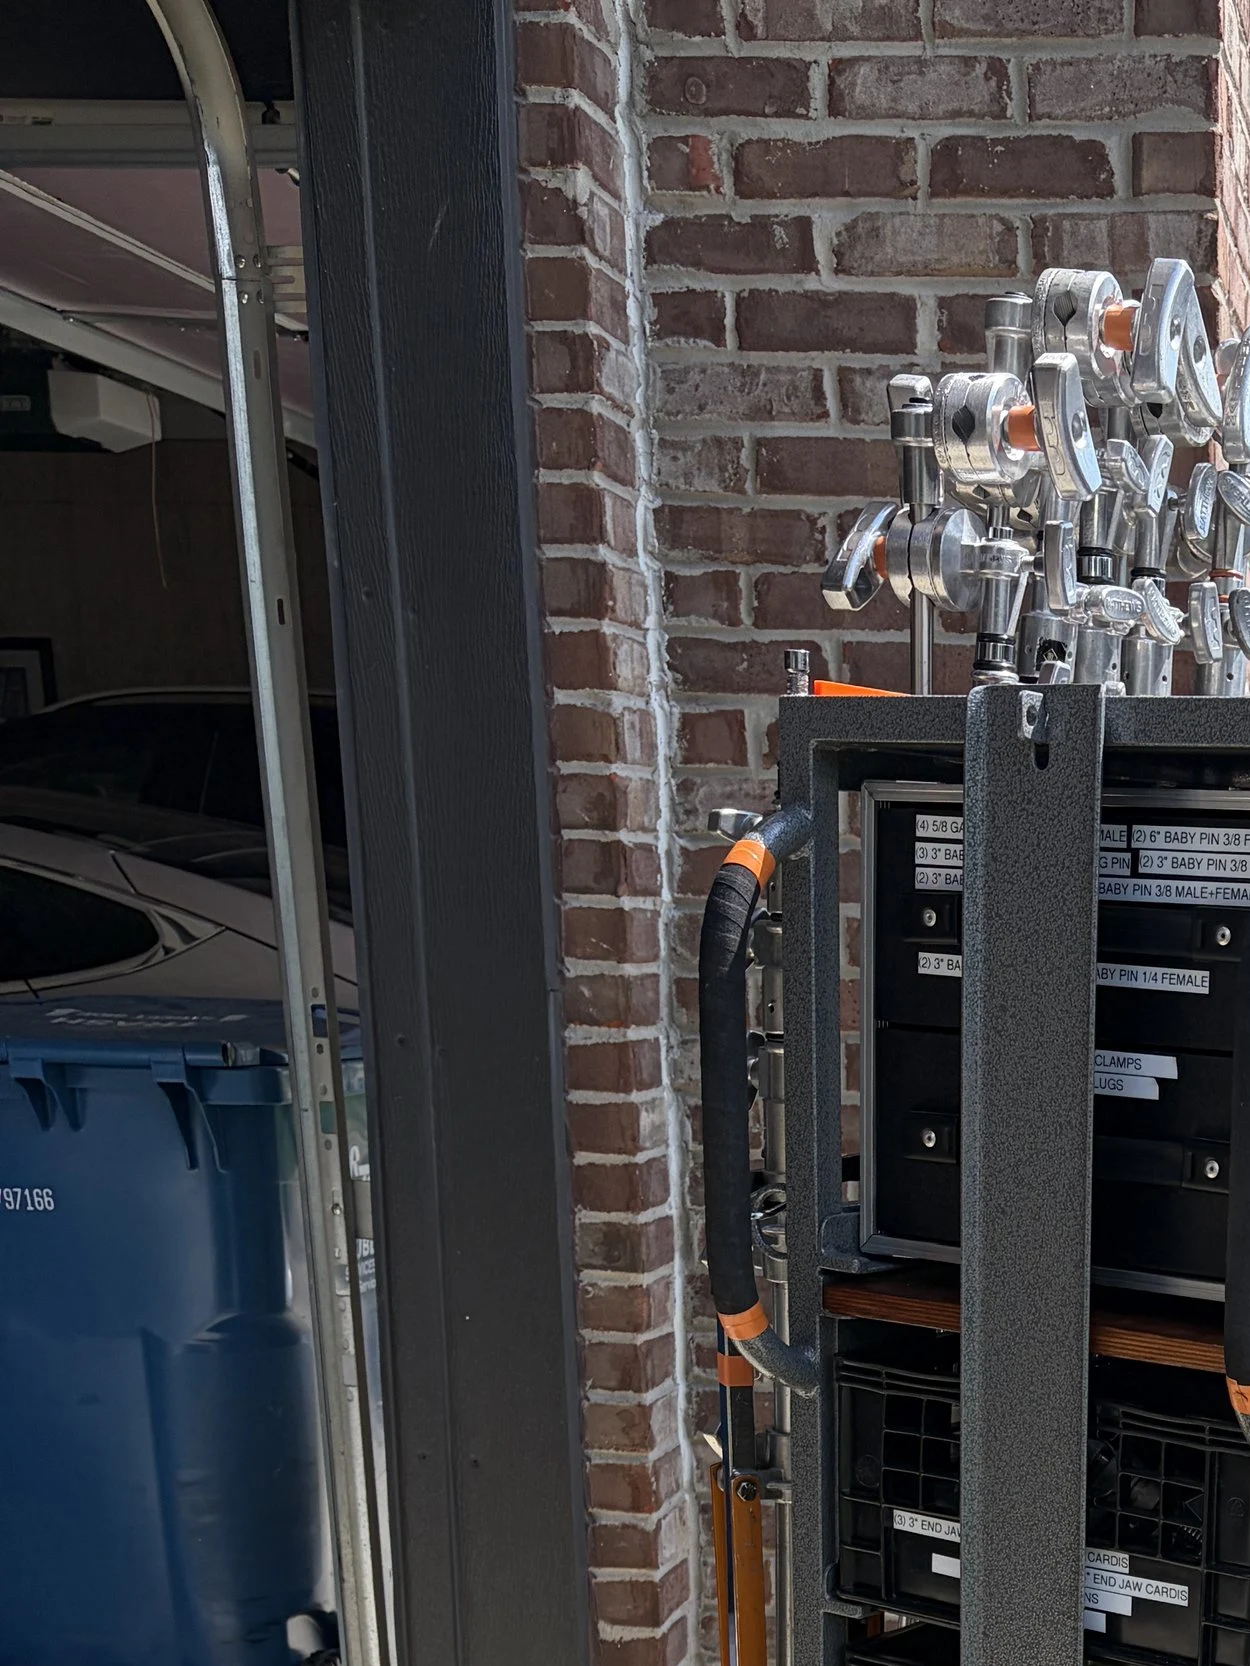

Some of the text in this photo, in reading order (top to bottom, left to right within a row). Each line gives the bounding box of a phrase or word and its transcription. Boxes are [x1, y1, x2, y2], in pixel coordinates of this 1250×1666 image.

[916, 820, 929, 832] (4)
[932, 820, 948, 833] 5/8
[1132, 830, 1146, 843] (2)
[1150, 830, 1160, 843] 6"
[1164, 831, 1197, 844] BABY
[1200, 832, 1219, 845] PIN
[1223, 833, 1240, 846] 3/8
[916, 847, 928, 860] (3)
[932, 848, 941, 860] 3"
[1111, 857, 1130, 869] PIN
[1140, 855, 1153, 868] (2)
[1157, 856, 1168, 868] 3"
[1171, 857, 1203, 870] BABY
[1207, 858, 1226, 871] PIN
[1230, 859, 1248, 872] 3/8
[916, 872, 929, 884] (2)
[932, 872, 941, 885] 3"
[1099, 882, 1129, 895] BABY
[1133, 883, 1152, 896] PIN
[1155, 884, 1172, 897] 3/8
[918, 956, 931, 969] (2)
[934, 958, 944, 969] 3"
[1120, 969, 1138, 982] PIN
[1143, 971, 1158, 984] 1/4
[1161, 972, 1208, 988] FEMALE
[1095, 1054, 1142, 1071] CLAMPS
[0, 1188, 55, 1211] 97166
[894, 1514, 906, 1527] (3)
[908, 1517, 918, 1528] 3"
[921, 1520, 942, 1534] END
[1087, 1551, 1128, 1569] CARDIS
[1093, 1573, 1116, 1587] END
[1119, 1579, 1143, 1592] JAW
[1145, 1584, 1188, 1601] CARDIS
